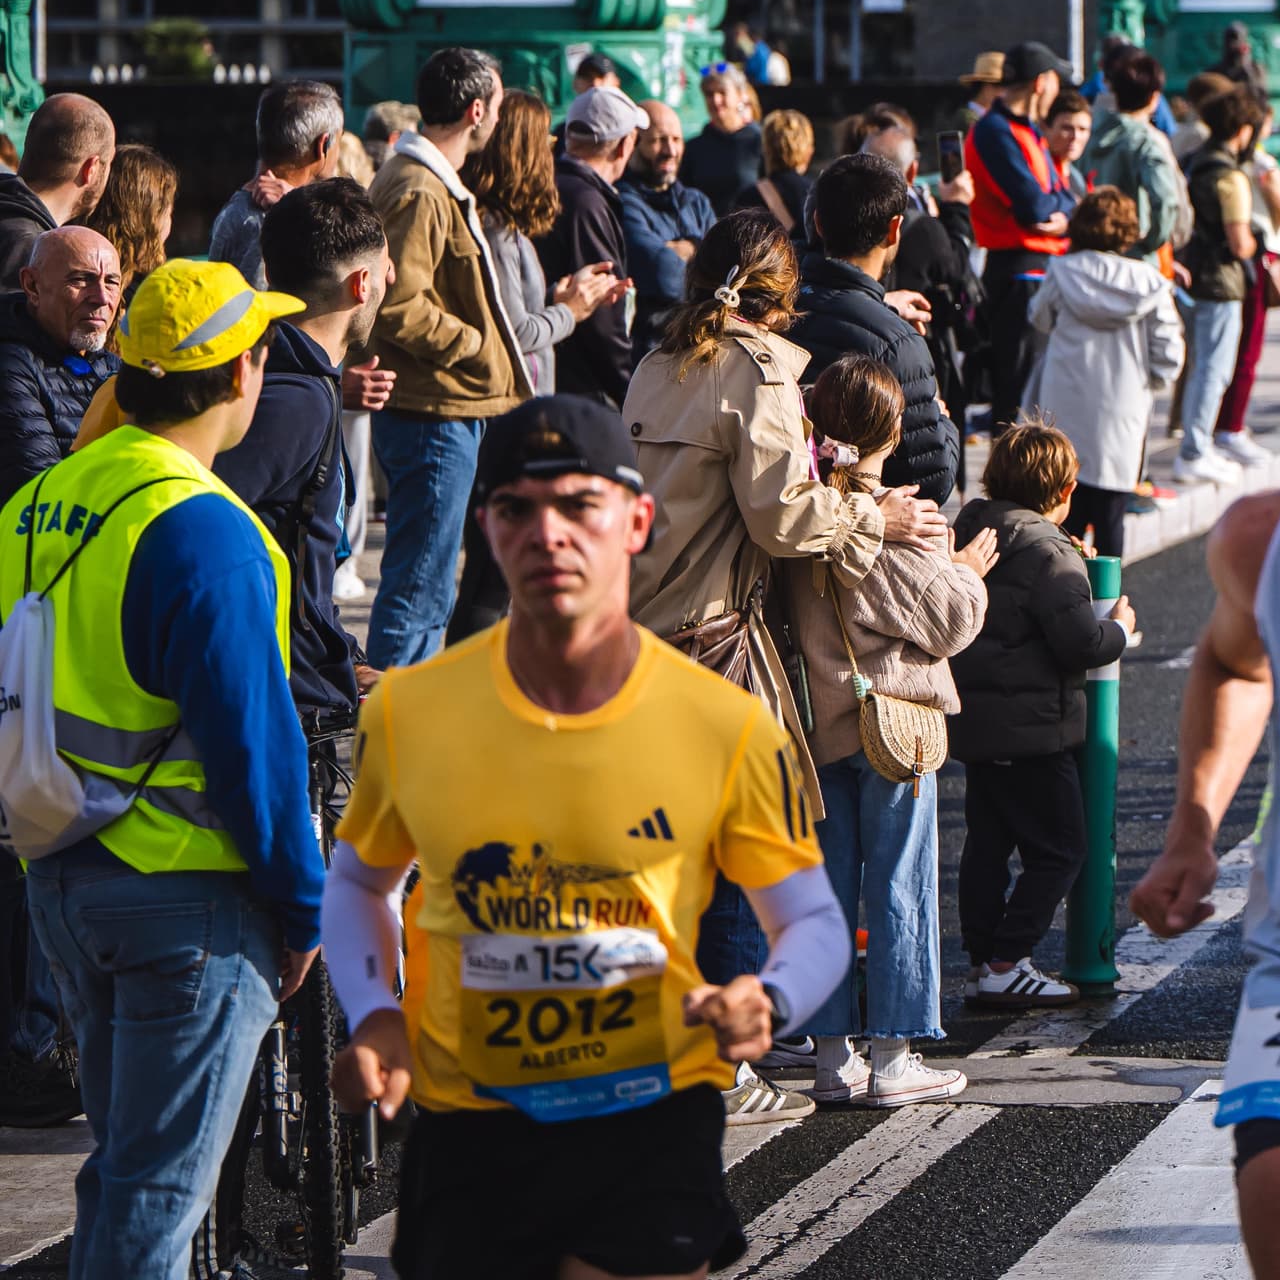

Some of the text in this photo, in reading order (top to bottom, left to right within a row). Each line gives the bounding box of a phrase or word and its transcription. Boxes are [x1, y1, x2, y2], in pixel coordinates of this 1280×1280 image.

[485, 896, 651, 932] WORLD RUN
[486, 989, 636, 1048] 2012
[519, 1041, 607, 1069] ALBERTO
